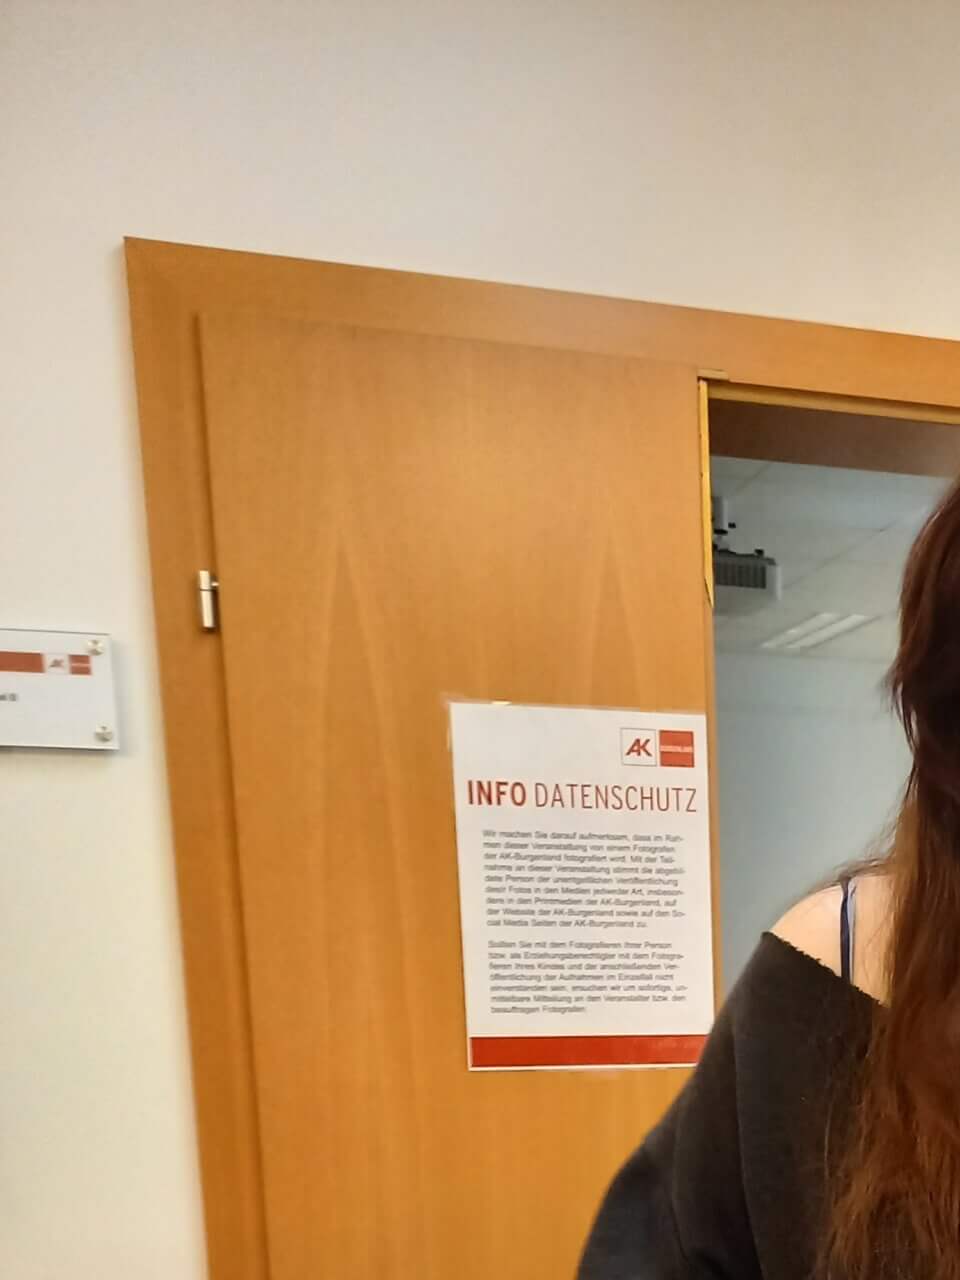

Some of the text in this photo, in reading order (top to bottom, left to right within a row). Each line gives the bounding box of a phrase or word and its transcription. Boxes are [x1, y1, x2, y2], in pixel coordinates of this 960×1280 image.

[624, 738, 653, 757] AK
[467, 779, 697, 813] INFO DATENSCHUTZ
